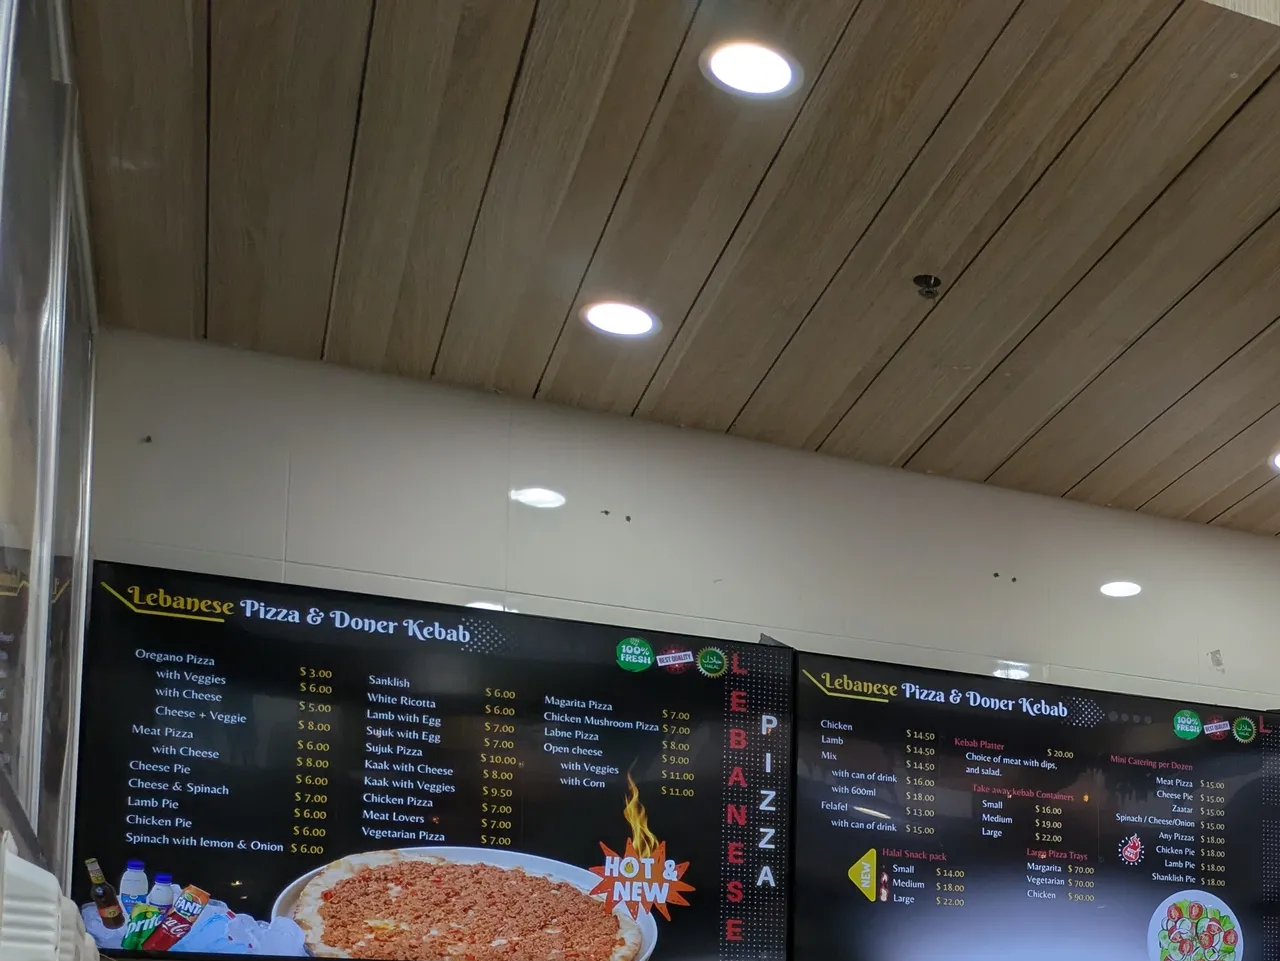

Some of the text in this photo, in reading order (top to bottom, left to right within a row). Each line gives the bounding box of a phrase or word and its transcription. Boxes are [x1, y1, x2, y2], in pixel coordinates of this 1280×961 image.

[128, 586, 471, 642] Lebanese Pizza & Doner Kebab
[622, 645, 650, 655] 100%
[135, 649, 215, 666] Oregano Pizza
[621, 654, 651, 664] FRESH
[672, 653, 691, 662] QUALITY
[156, 669, 226, 686] with Veggies
[309, 668, 332, 678] 3.00
[369, 675, 410, 688] Sanklish
[156, 687, 222, 702] with Cheese
[367, 692, 436, 708] White Ricotta
[821, 672, 1068, 717] Lebanese Pizza & Doner Kebab
[544, 696, 613, 711] Magarita Pizza
[156, 706, 196, 719] Cheese
[209, 711, 247, 724] Veggie
[544, 712, 659, 732] Chicken Mushroom Pizza
[132, 725, 194, 739] Meat Pizza
[820, 720, 852, 730] Chicken
[821, 735, 844, 745] Lamb
[954, 738, 1004, 750] Kebab Platter
[822, 751, 837, 760] Mix
[966, 752, 1058, 770] Choice of meat with dips,
[1111, 755, 1193, 770] Mini Catering per Dozen
[966, 766, 979, 774] and
[128, 779, 229, 795] Cheese & Spinach
[832, 785, 876, 796] with 600ml
[726, 653, 748, 941] LEBANESE
[756, 714, 778, 887] PIZZA
[821, 801, 848, 812] Felafel
[1172, 805, 1193, 814] Zaatar
[126, 814, 192, 828] Chicken Pie
[362, 826, 445, 841] Vegetarian Pizza
[126, 832, 284, 852] Spinach with lemon & Onion
[882, 848, 947, 862] Halal Snack pack
[605, 856, 678, 881] HOT &
[861, 861, 872, 888] NEW
[893, 864, 914, 874] Small
[893, 878, 924, 889] Medium
[613, 881, 669, 903] NEW
[893, 894, 914, 904] Large
